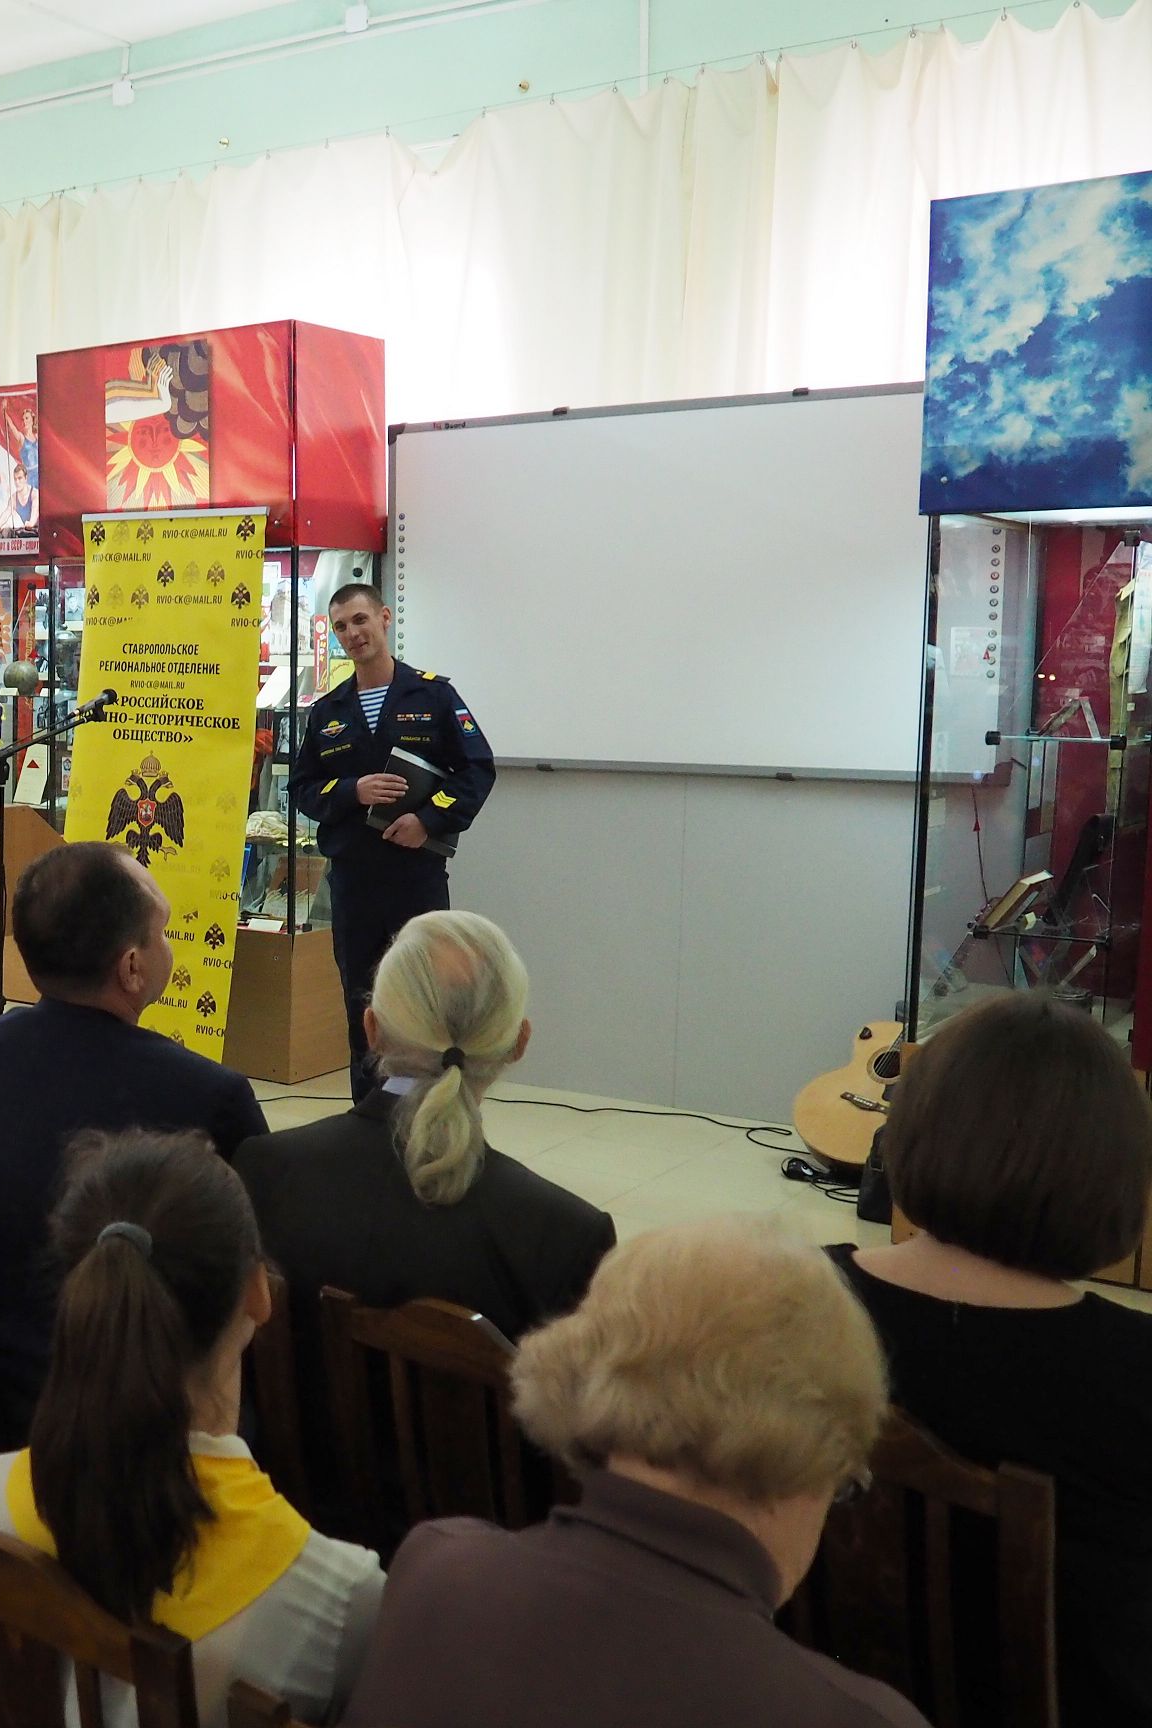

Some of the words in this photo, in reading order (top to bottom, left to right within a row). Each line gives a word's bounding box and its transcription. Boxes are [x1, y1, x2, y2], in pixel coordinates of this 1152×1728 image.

[122, 643, 199, 656] СТАВРОПОЛЬСКОЕ
[99, 660, 166, 673] РЕГИОНАЛЬНОЕ
[168, 662, 221, 675] ОТДЕЛЕНИЕ
[112, 728, 193, 743] ОБЩЕСТВО»
